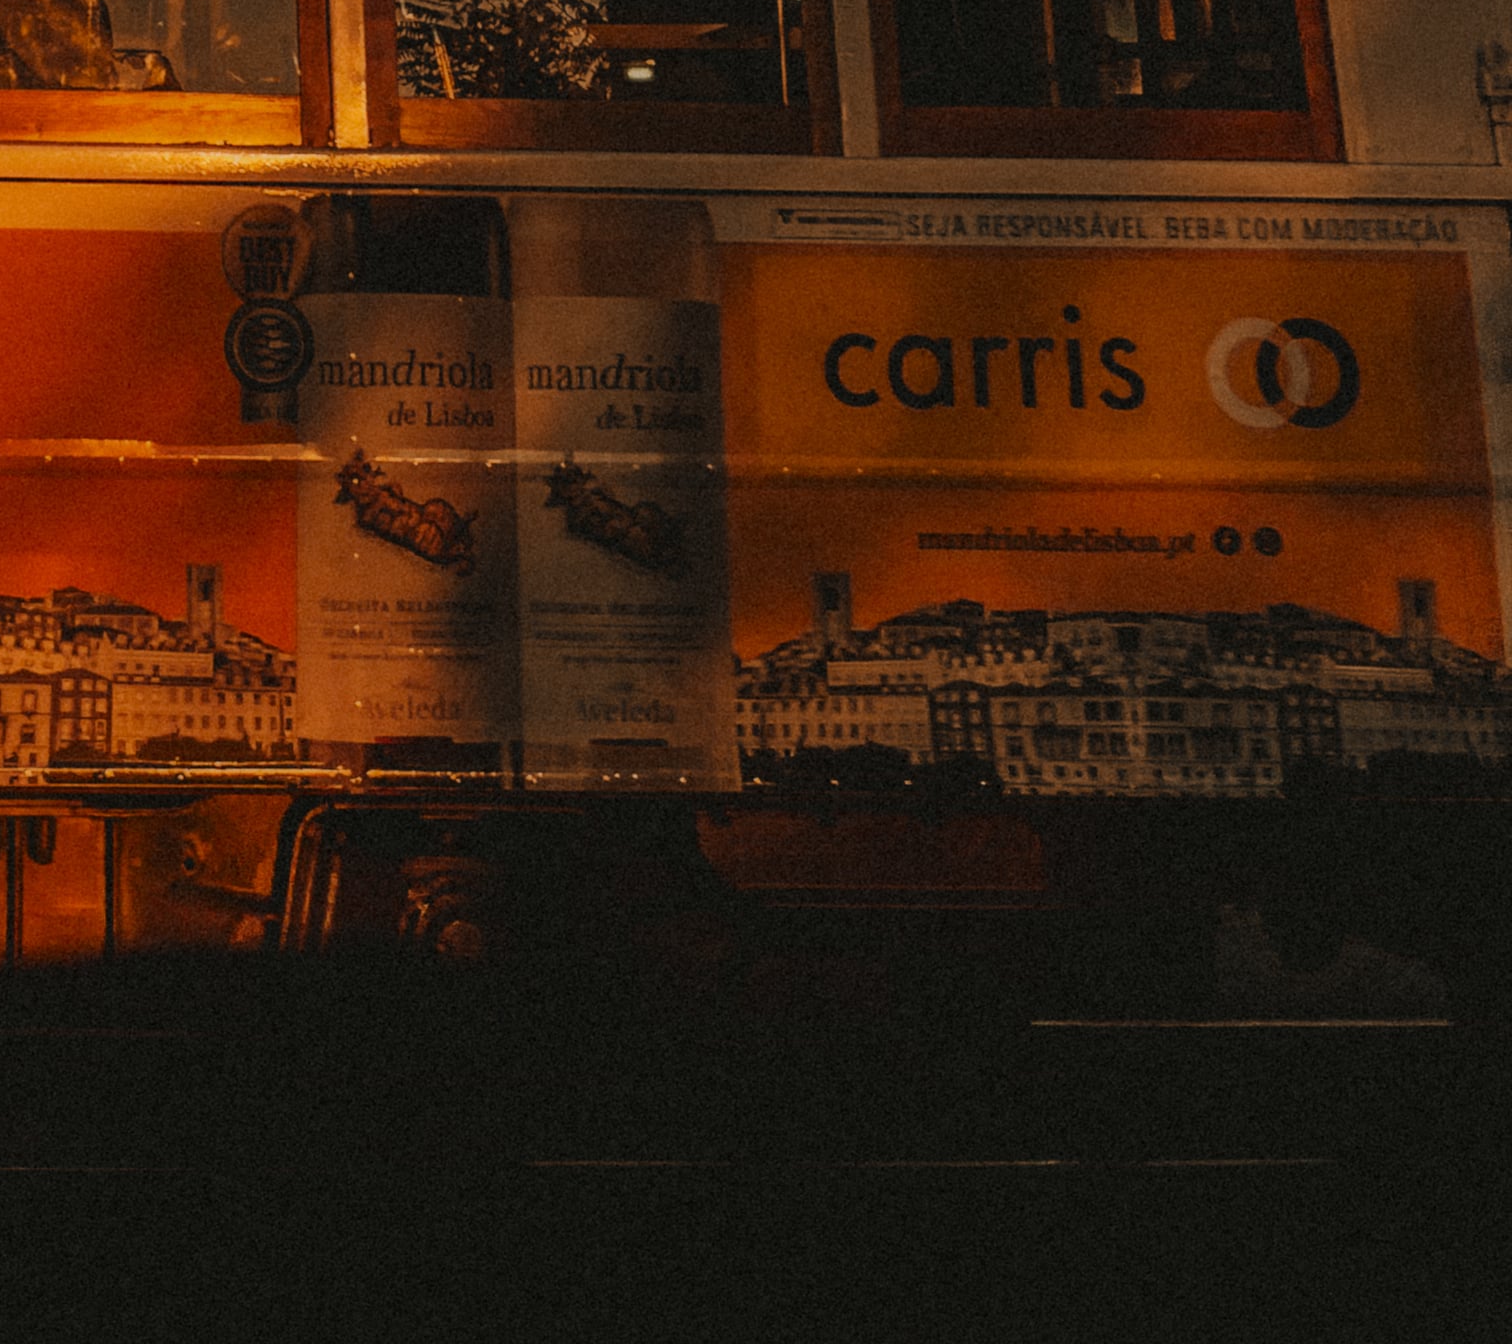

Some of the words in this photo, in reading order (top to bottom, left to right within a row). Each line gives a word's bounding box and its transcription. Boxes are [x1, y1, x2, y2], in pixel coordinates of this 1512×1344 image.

[905, 213, 968, 237] SEJA
[1163, 215, 1228, 241] BEBA
[1236, 216, 1294, 242] COM
[317, 348, 496, 392] mandriola
[526, 352, 704, 394] mandriola
[822, 303, 1149, 412] carris
[386, 401, 417, 427] de
[426, 400, 496, 430] Lisboa
[596, 404, 628, 431] de
